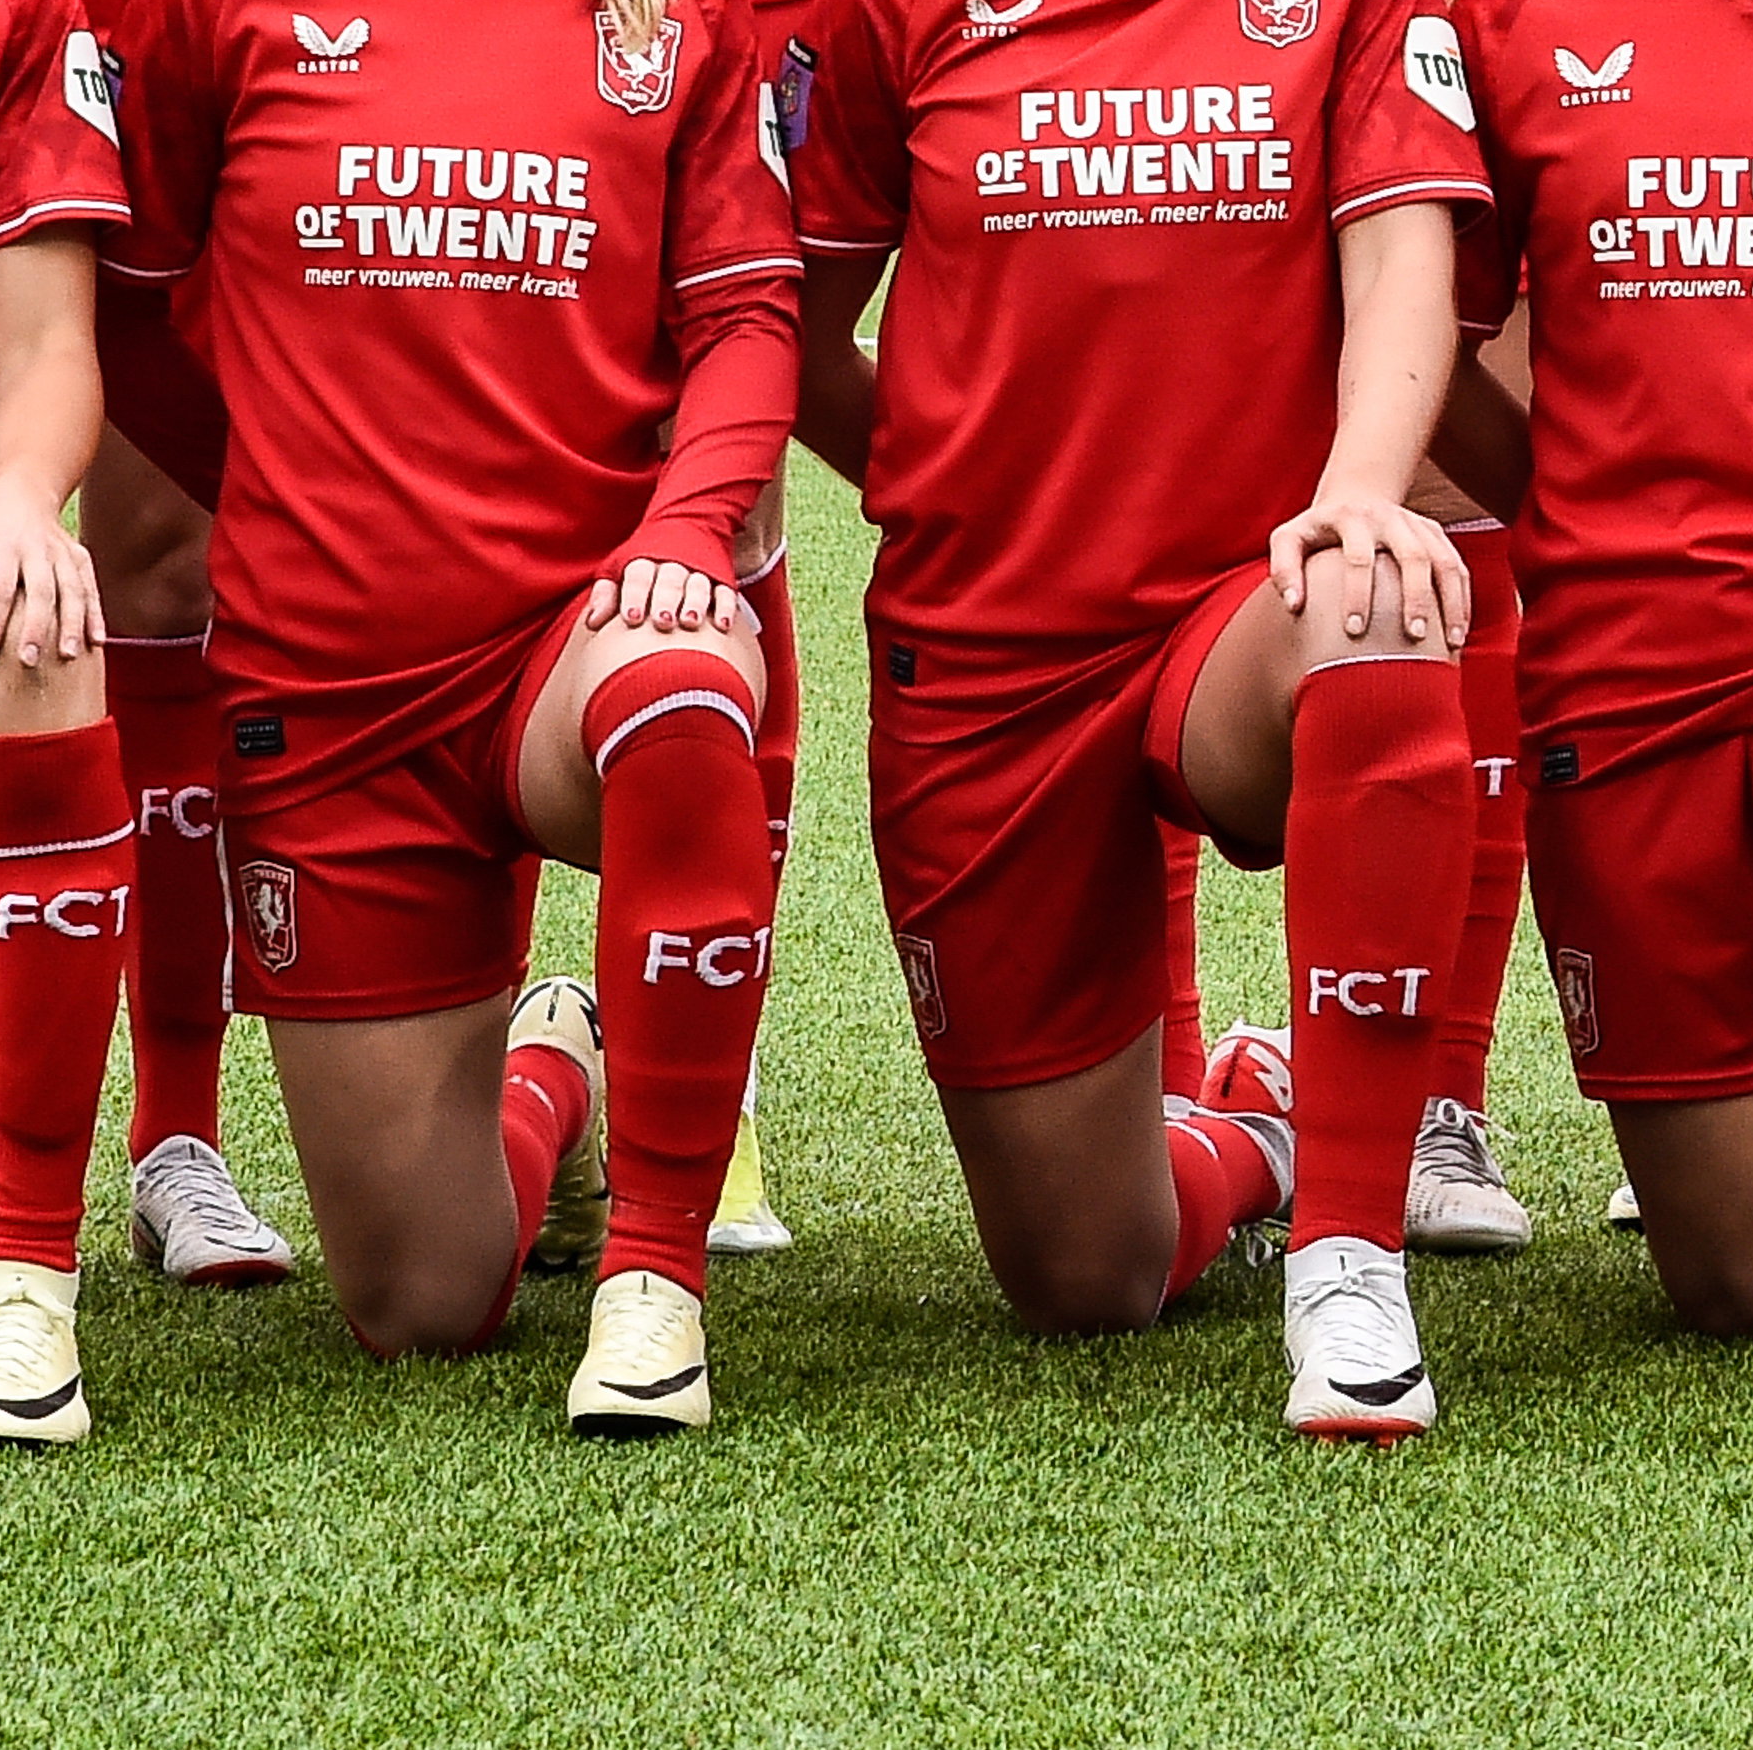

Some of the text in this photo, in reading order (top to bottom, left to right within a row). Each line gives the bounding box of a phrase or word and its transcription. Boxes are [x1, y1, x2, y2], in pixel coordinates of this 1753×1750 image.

[73, 67, 108, 106] TO
[296, 58, 360, 74] CASTOR
[1413, 51, 1468, 93] TOT
[1020, 84, 1275, 142] FUTURE
[337, 145, 590, 210] FUTURE
[975, 140, 1292, 198] OF TWENTE
[295, 204, 597, 270] OF TWENTE
[983, 199, 1289, 233] meer vrouwen. meer kracht.
[1589, 217, 1636, 263] OF
[304, 266, 355, 287] meer
[358, 267, 455, 289] vrouwen.
[459, 270, 520, 294] meer
[1648, 279, 1747, 301] vrouwen.
[140, 785, 219, 838] FC
[1308, 966, 1431, 1017] FCT
